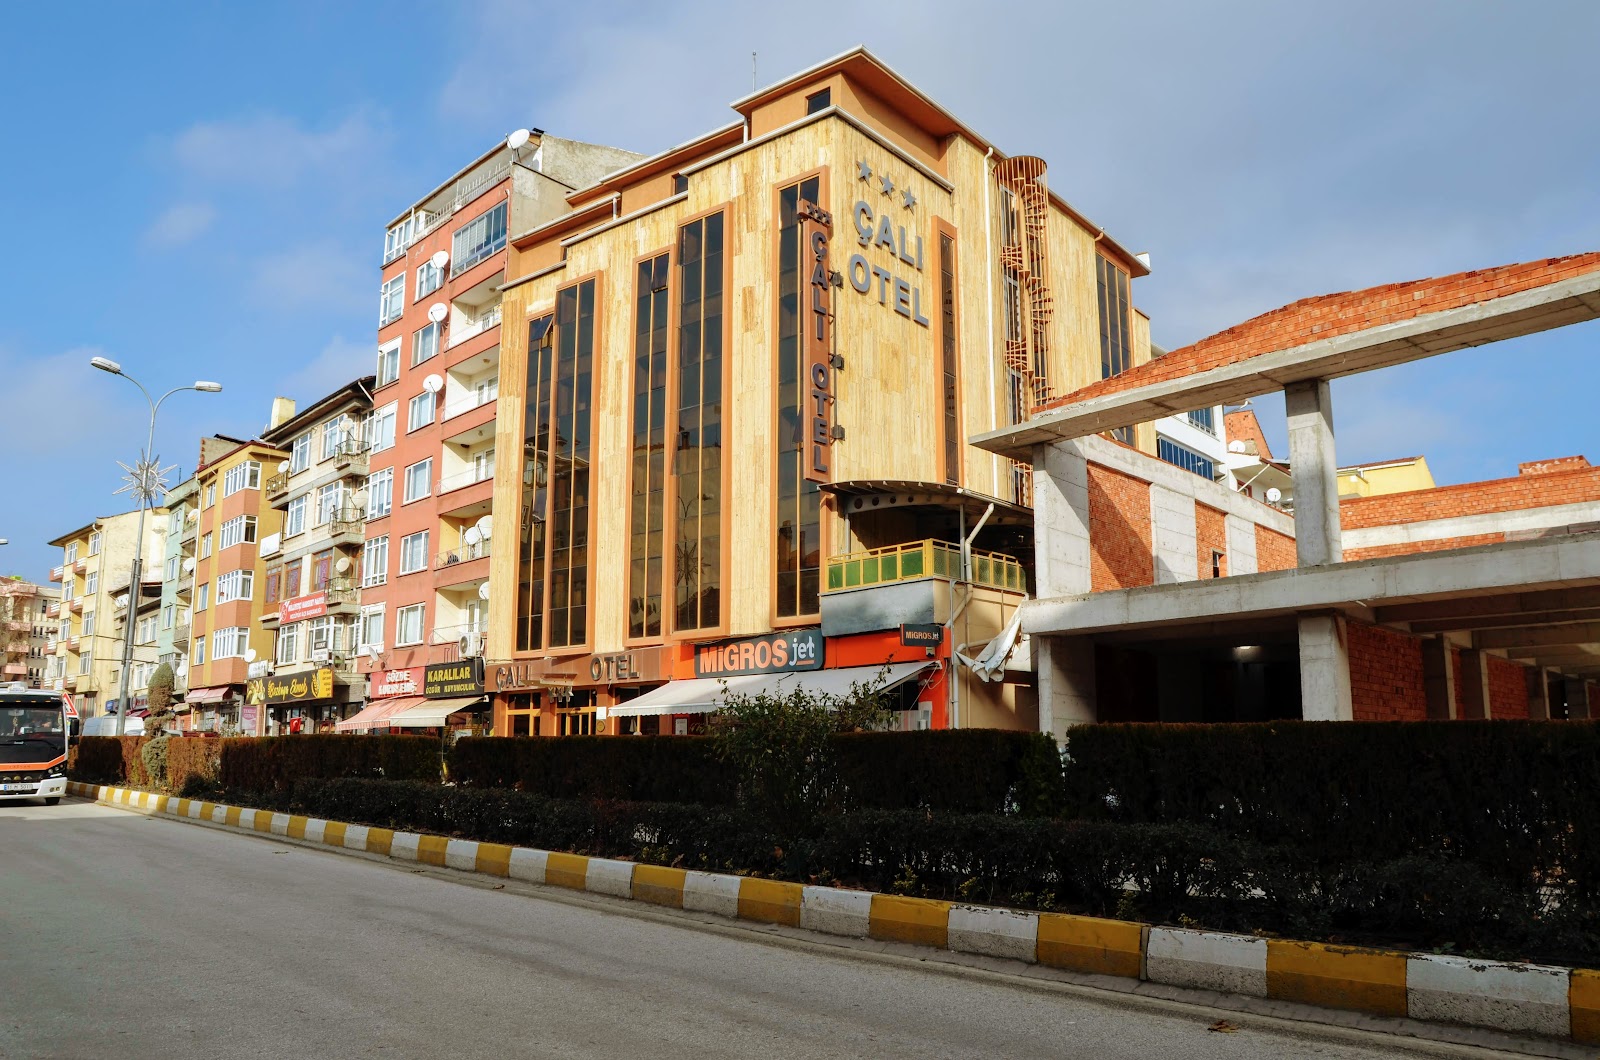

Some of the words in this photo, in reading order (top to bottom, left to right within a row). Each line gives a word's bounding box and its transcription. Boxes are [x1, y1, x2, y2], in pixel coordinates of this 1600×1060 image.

[853, 200, 923, 272] ÇALI
[811, 231, 828, 341] ÇALI
[849, 253, 929, 327] OTEL
[811, 362, 828, 473] OTEL
[427, 666, 471, 683] KARALILAR
[496, 664, 532, 693] ÇALI
[590, 655, 640, 681] OTEL
[789, 635, 815, 666] jet
